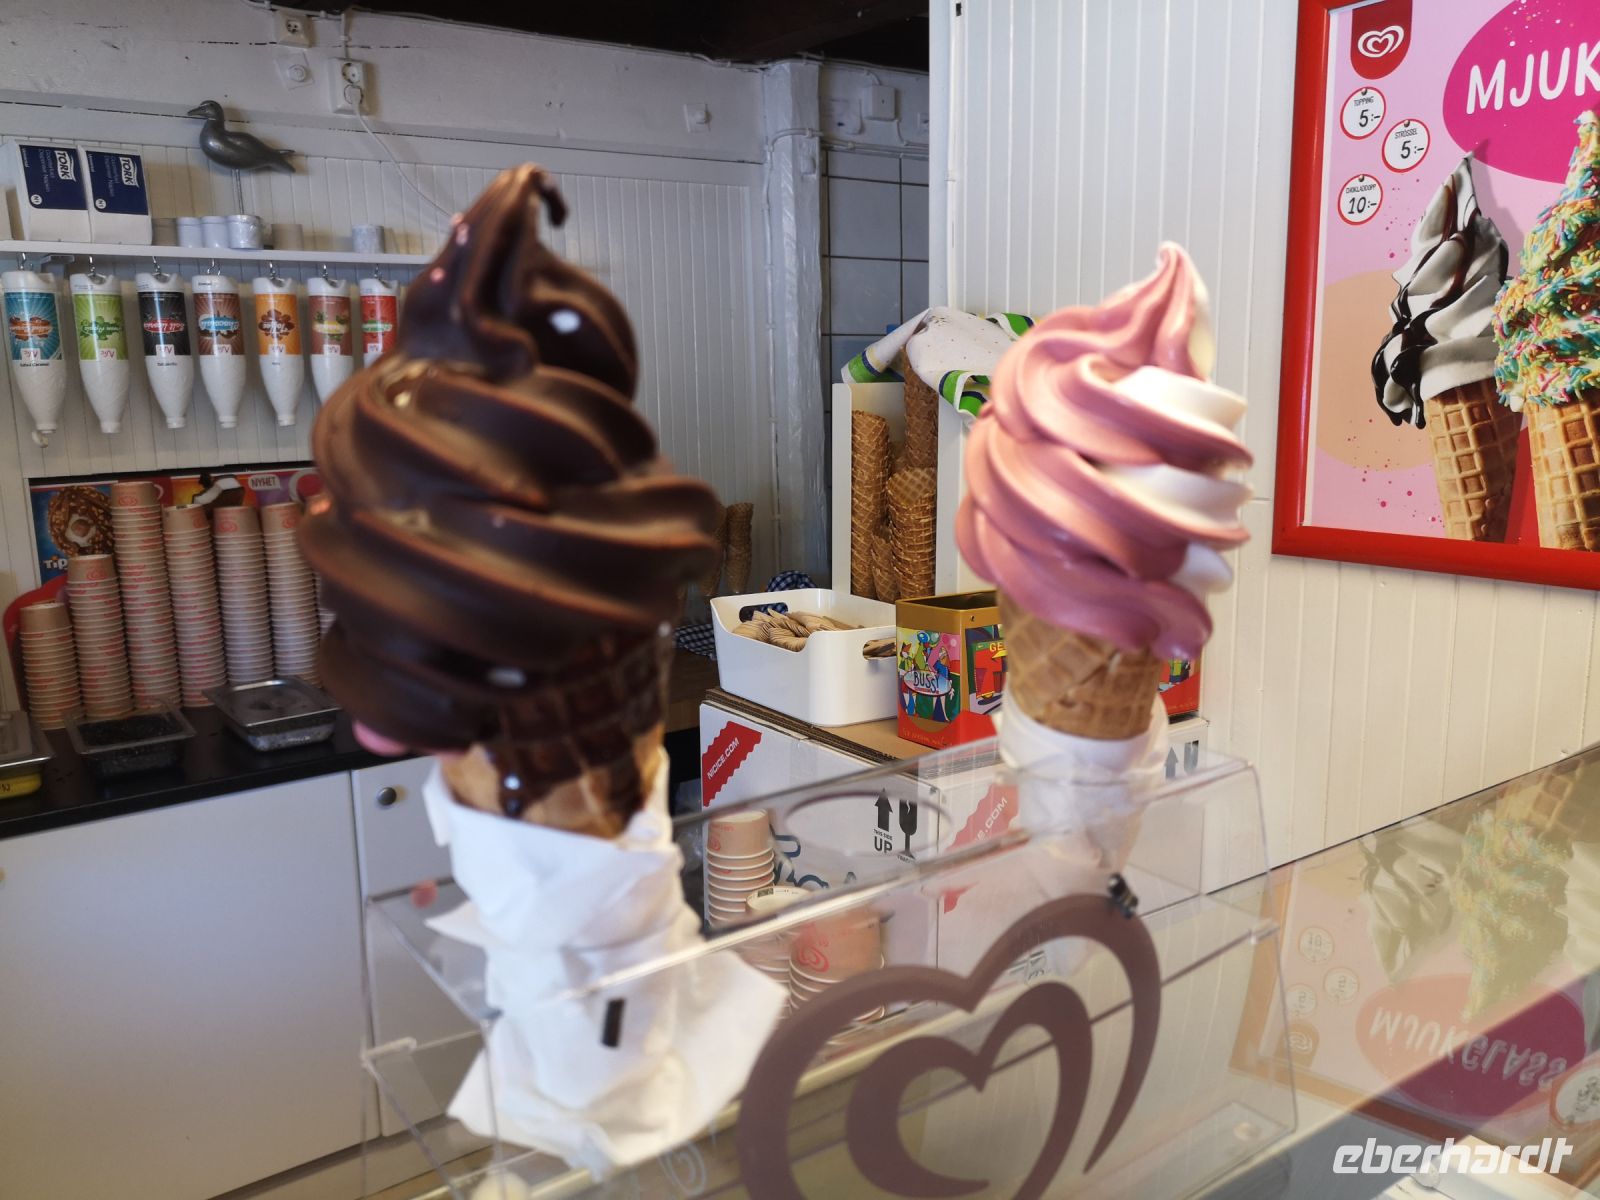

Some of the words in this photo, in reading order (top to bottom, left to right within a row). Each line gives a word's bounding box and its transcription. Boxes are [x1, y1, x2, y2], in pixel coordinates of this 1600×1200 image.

[1466, 41, 1600, 115] MJUK
[1359, 109, 1380, 127] 5:-
[1400, 140, 1424, 159] 5:-
[57, 152, 72, 178] TORK
[121, 158, 134, 183] TORK
[1348, 197, 1377, 214] 10:-
[251, 476, 276, 488] NYHET
[913, 671, 940, 693] BUSSY
[707, 737, 740, 779] NICICE.COM
[874, 835, 893, 854] UP
